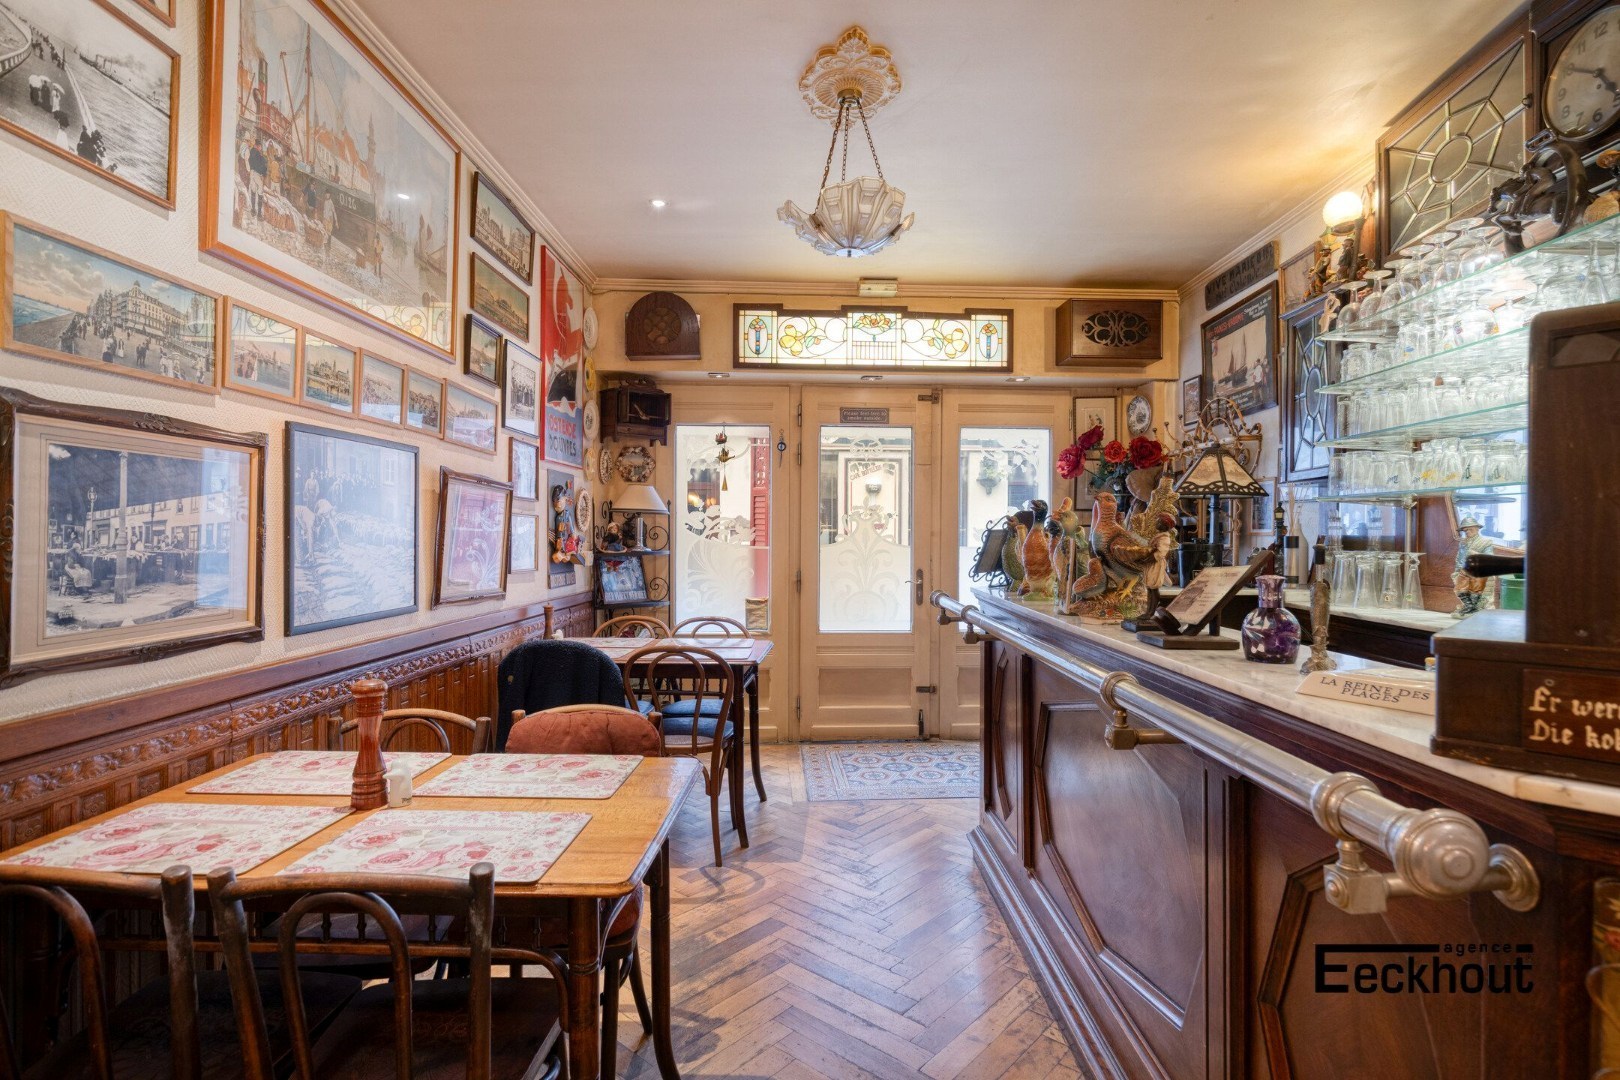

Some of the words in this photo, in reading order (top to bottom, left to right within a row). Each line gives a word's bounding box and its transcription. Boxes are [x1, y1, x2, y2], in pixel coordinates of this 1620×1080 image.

[1594, 21, 1609, 39] 12
[1558, 87, 1567, 102] 9
[1562, 104, 1571, 119] 8
[1575, 110, 1585, 126] 7
[1592, 107, 1603, 123] 6
[548, 413, 577, 440] OSTENDE
[549, 433, 577, 457] DOUVRES
[1320, 677, 1338, 686] LA
[1344, 680, 1394, 694] REINE
[1398, 688, 1431, 701] DES
[1341, 687, 1401, 703] PLAGES
[1571, 699, 1620, 719] wer
[1528, 718, 1574, 746] Die
